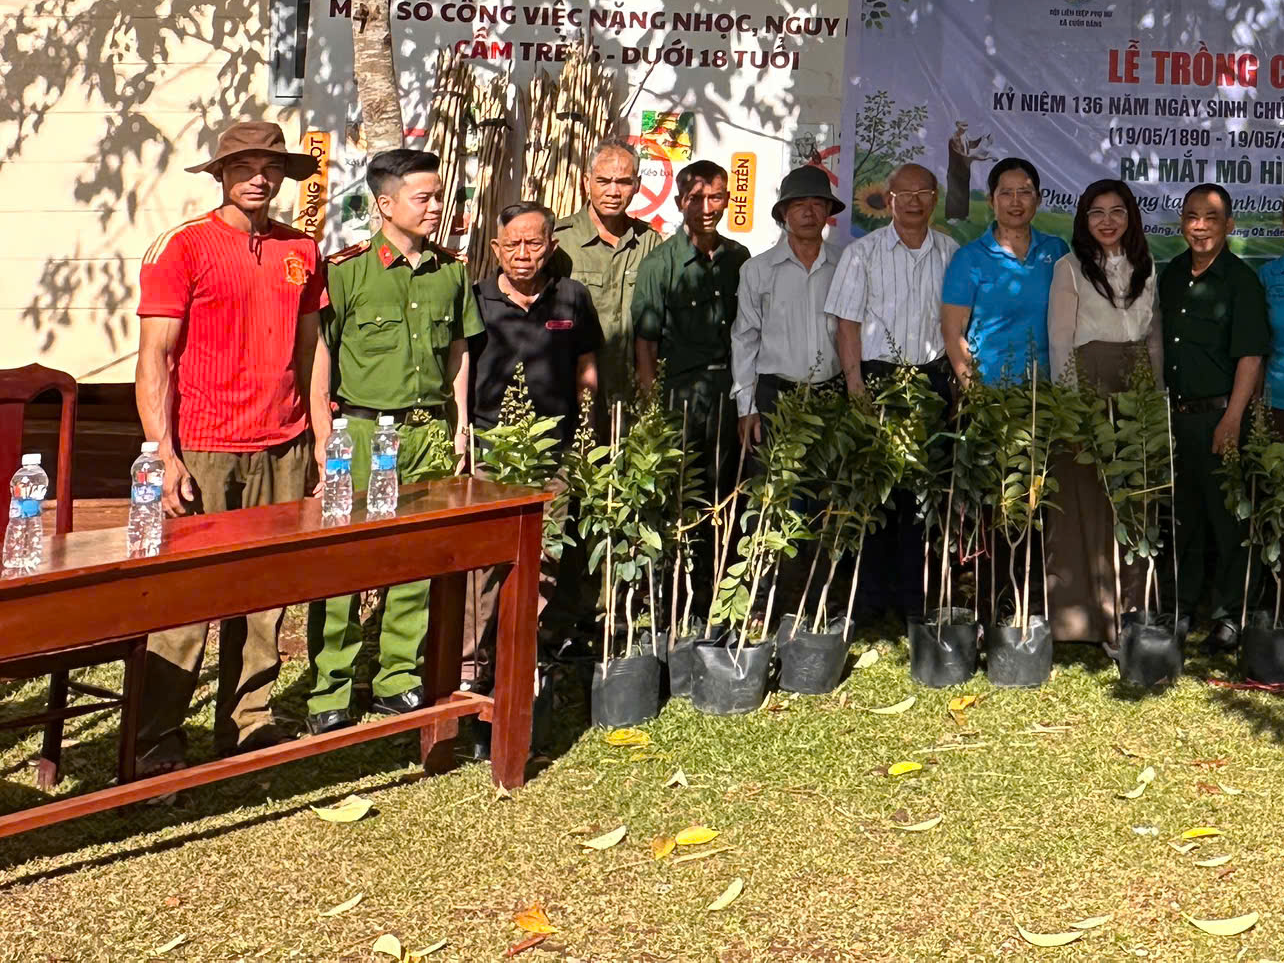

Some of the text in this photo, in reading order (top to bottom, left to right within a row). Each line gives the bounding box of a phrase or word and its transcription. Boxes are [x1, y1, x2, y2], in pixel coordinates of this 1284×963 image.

[523, 0, 583, 34] VIỆC
[589, 1, 666, 36] NẶNG
[673, 12, 758, 40] NHỌC,
[766, 15, 840, 37] NGUY
[454, 27, 513, 61] CẤM
[622, 39, 695, 67] DƯỚI
[700, 50, 728, 68] 18
[734, 37, 799, 70] TUỔI
[1108, 39, 1140, 83] LỄ
[1151, 40, 1260, 88] TRỒNG
[993, 87, 1015, 111] KỶ
[1021, 91, 1066, 116] NIỆM
[1072, 96, 1103, 114] 136
[1108, 94, 1149, 115] NĂM
[1154, 95, 1201, 117] NGÀY
[1207, 100, 1248, 119] SINH
[1109, 127, 1210, 147] (19/05/1890
[1121, 157, 1149, 181] RA
[1158, 149, 1208, 183] MẮT
[1216, 154, 1251, 184] MÔ
[731, 158, 750, 226] CHẾ BIẾN
